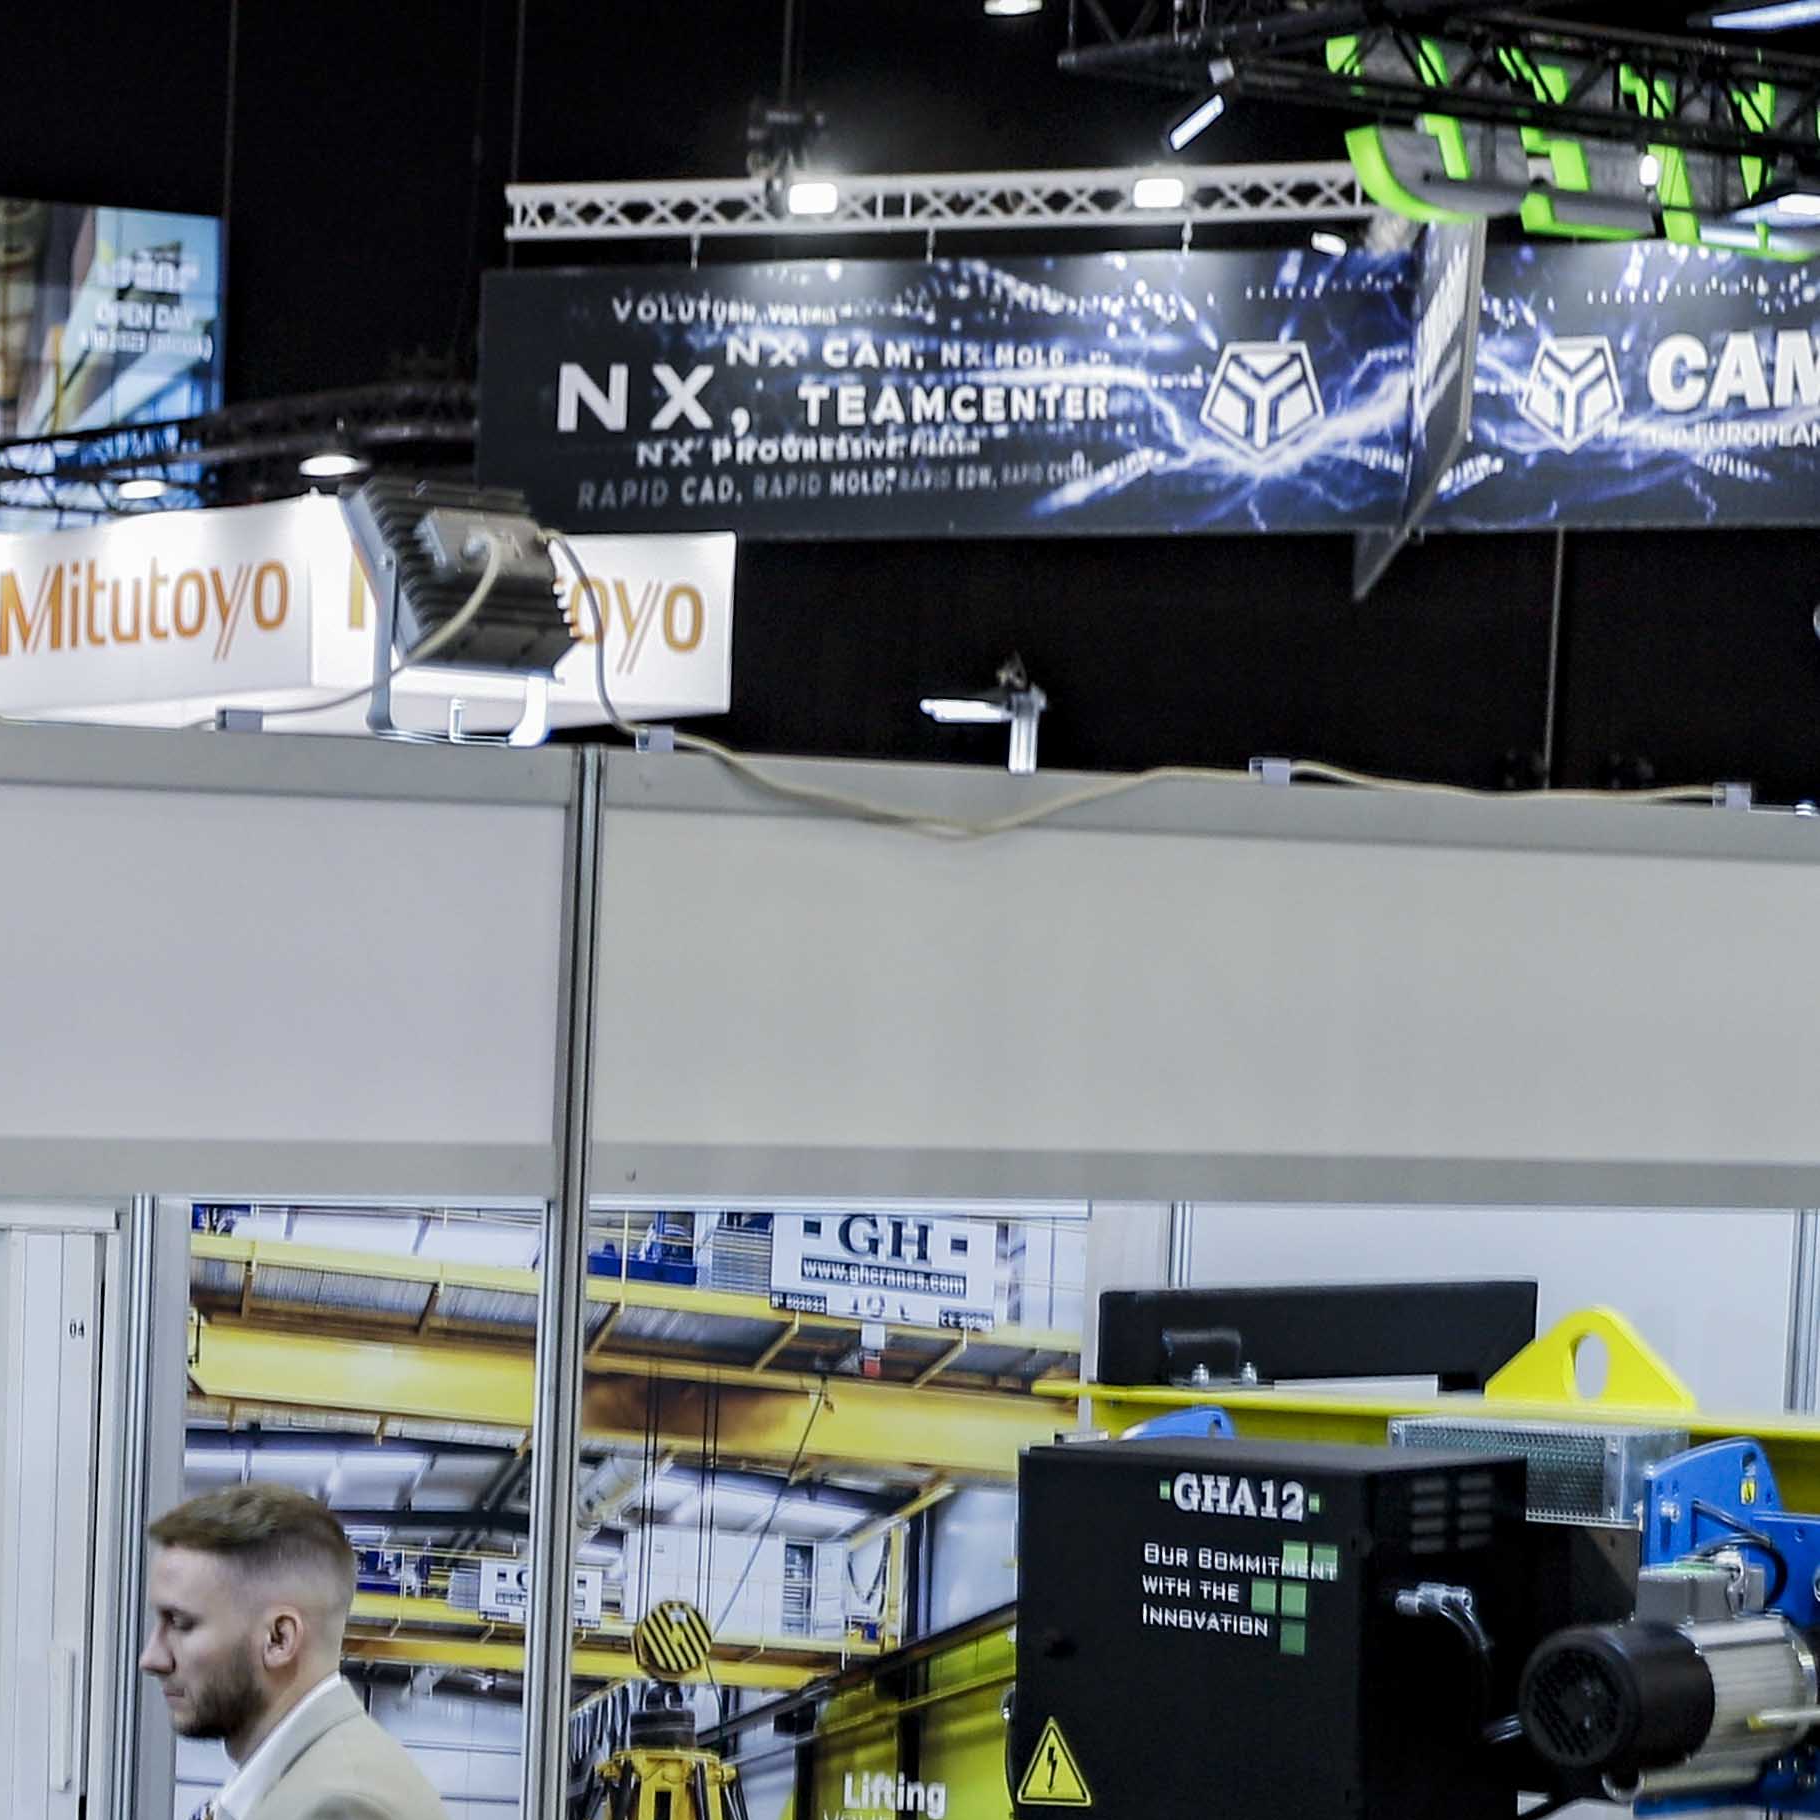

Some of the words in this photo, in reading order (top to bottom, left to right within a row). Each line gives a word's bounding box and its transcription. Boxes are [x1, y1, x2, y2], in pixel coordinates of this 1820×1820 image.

[558, 362, 751, 438] NX,
[797, 383, 1110, 427] TEAMCENTER
[576, 477, 669, 509] RAPID
[681, 476, 743, 503] CAD,
[1173, 1471, 1305, 1522] GHA12
[844, 1770, 947, 1820] Lifting
